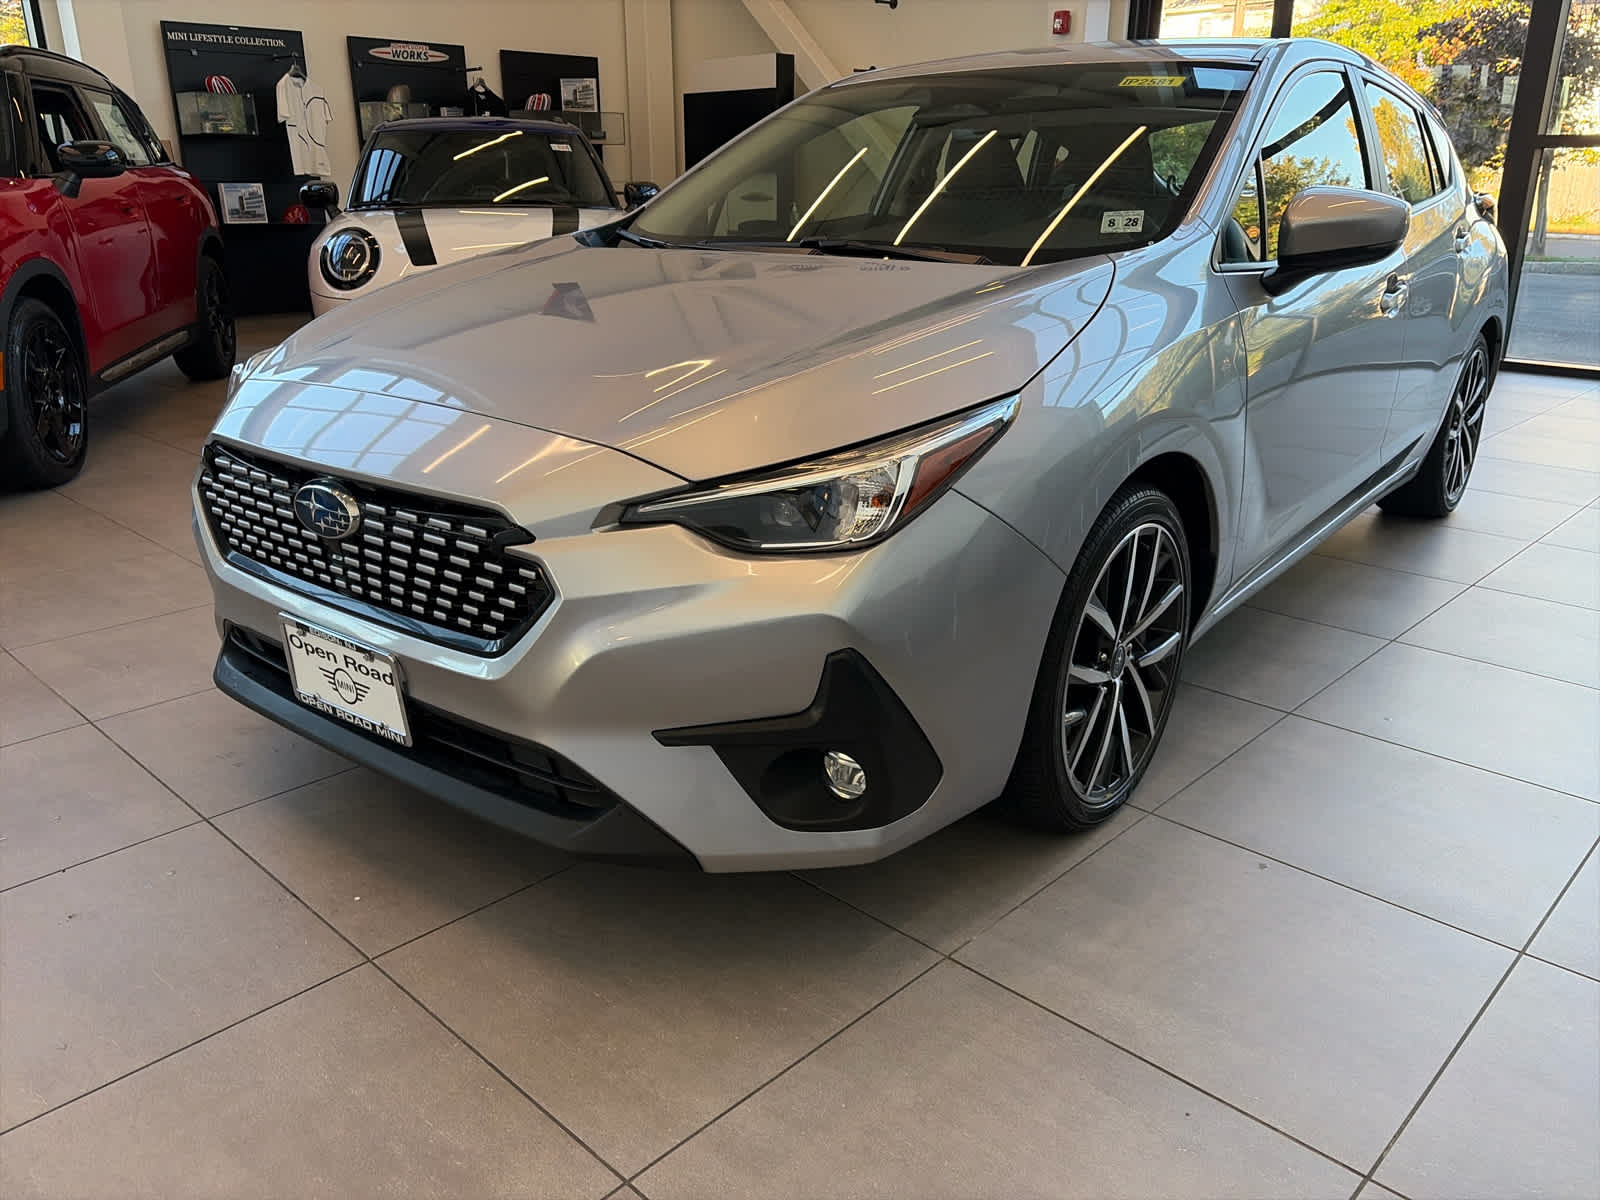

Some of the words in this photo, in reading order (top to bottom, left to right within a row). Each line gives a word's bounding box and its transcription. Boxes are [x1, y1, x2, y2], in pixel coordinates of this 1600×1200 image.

[166, 31, 188, 41] MINI
[189, 33, 234, 44] LIFESTYLE
[391, 50, 429, 60] WORKS
[1107, 218, 1116, 228] 8
[1123, 217, 1139, 227] 28
[289, 634, 338, 664] Open
[344, 657, 394, 687] Road
[336, 679, 355, 695] MINI
[300, 693, 334, 716] OPEN
[336, 703, 372, 732] ROAD
[375, 726, 405, 746] MINI
